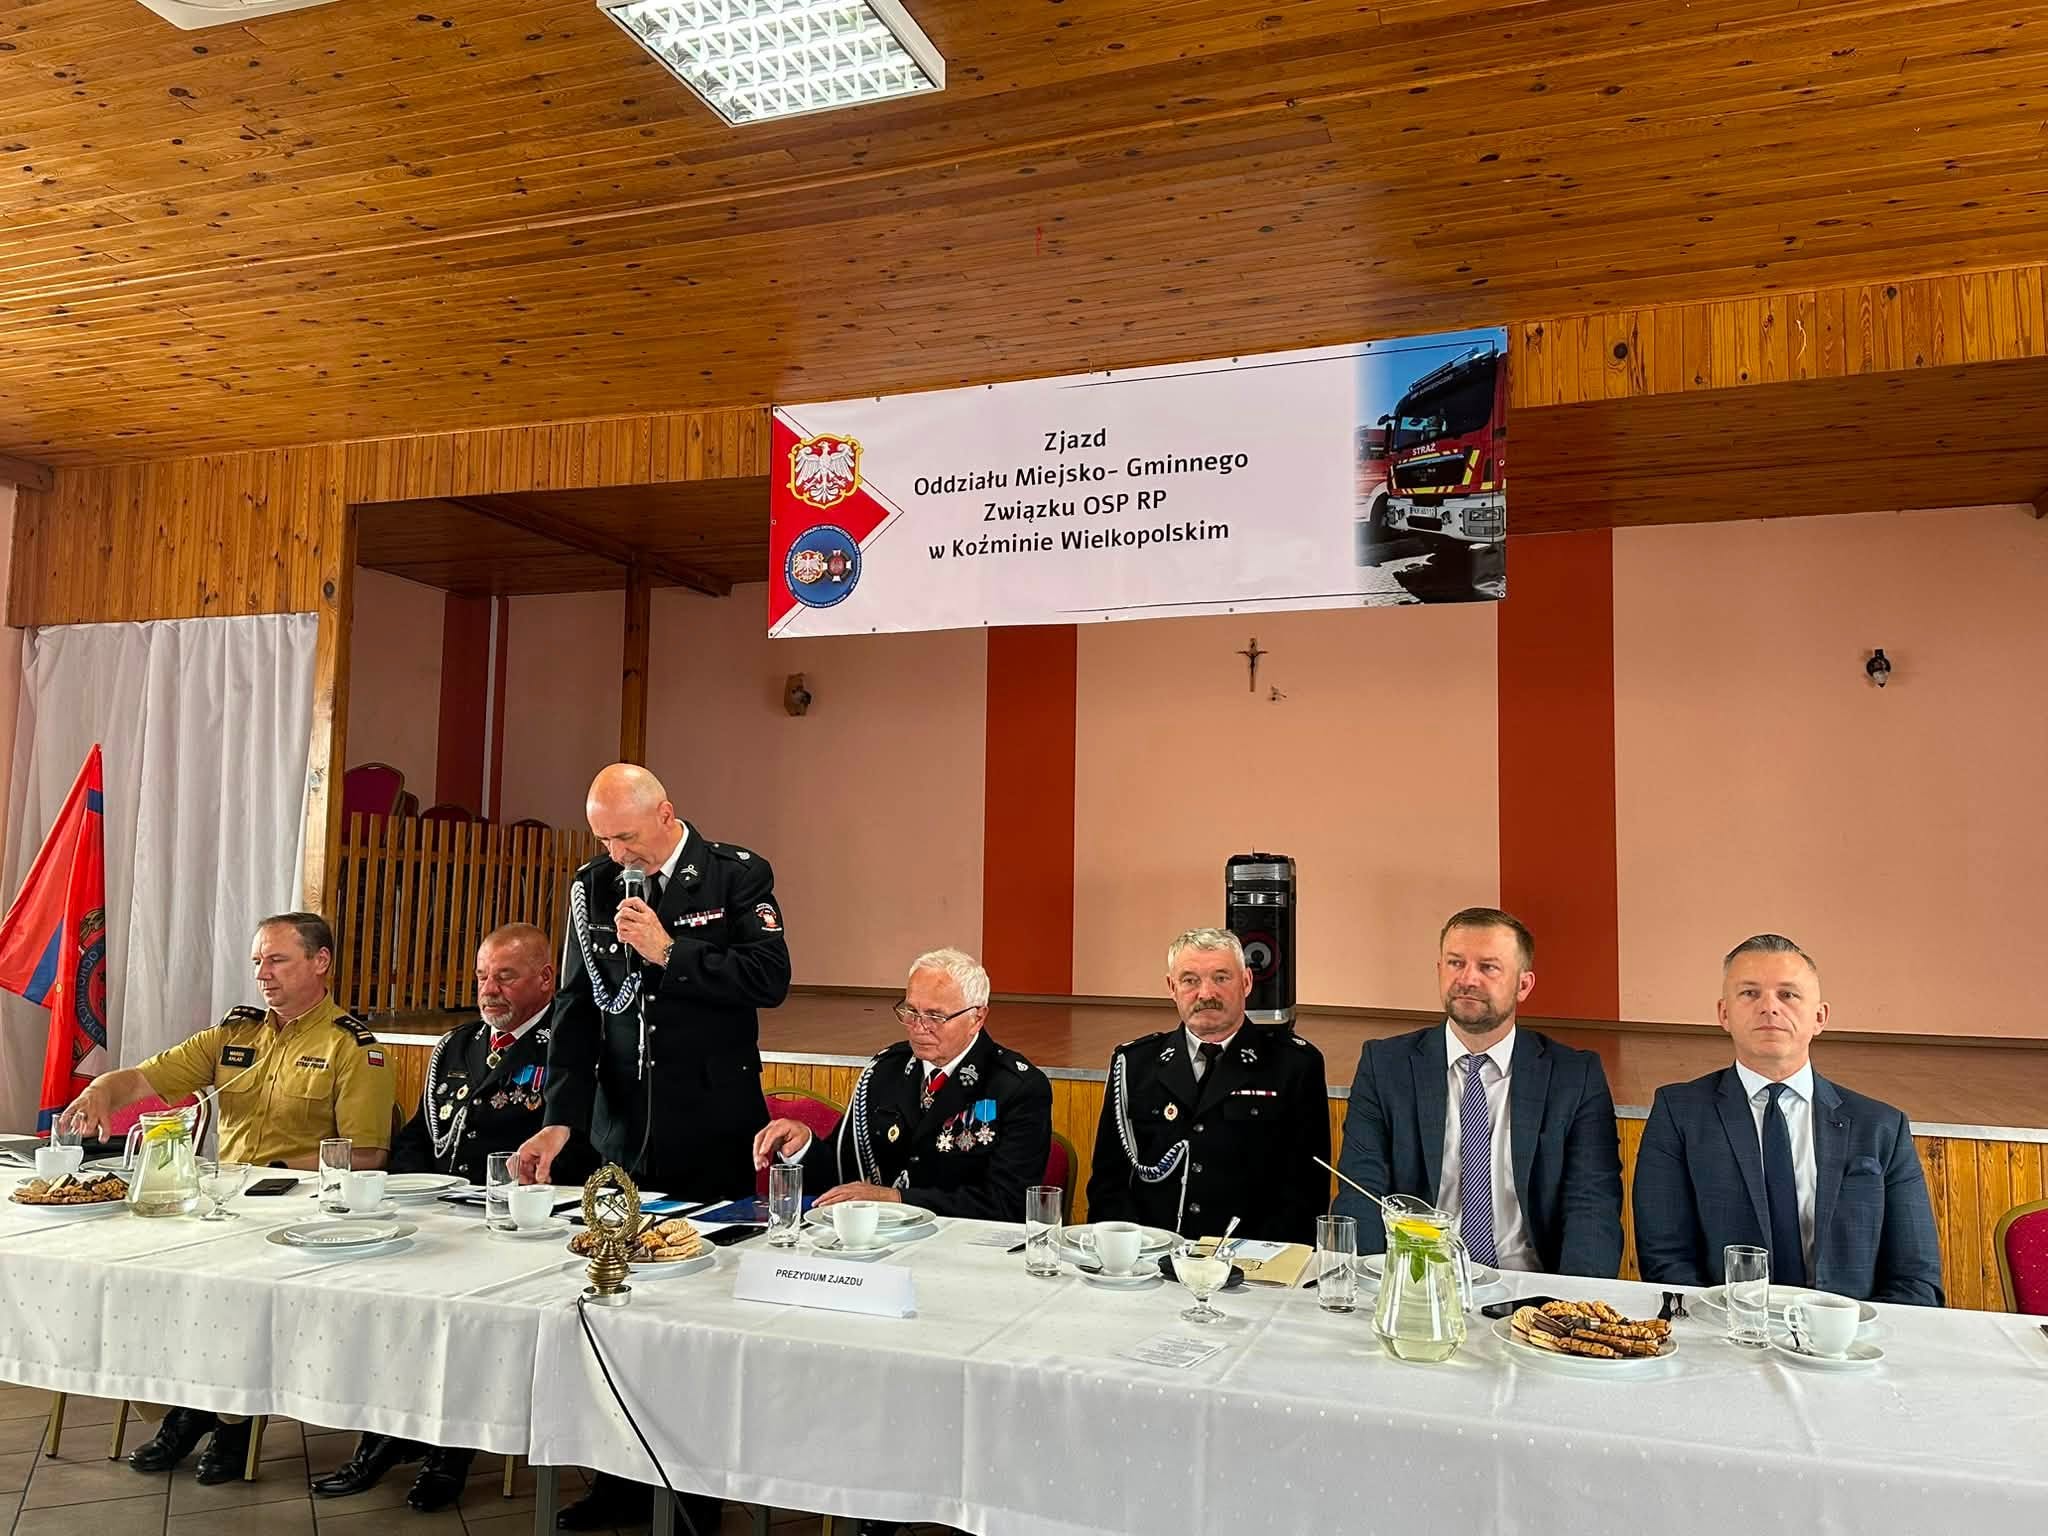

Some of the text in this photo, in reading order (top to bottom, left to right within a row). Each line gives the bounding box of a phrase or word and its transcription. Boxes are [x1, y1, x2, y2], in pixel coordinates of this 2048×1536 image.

[1044, 427, 1106, 455] Zjazd
[914, 453, 1249, 496] Oddziału Miejsko- Gminnego
[983, 489, 1168, 525] Związku OSP RP
[928, 519, 1230, 560] w Koźminie Wielkopolskim
[775, 1268, 864, 1287] PREZYDIUM ZJAZDU
